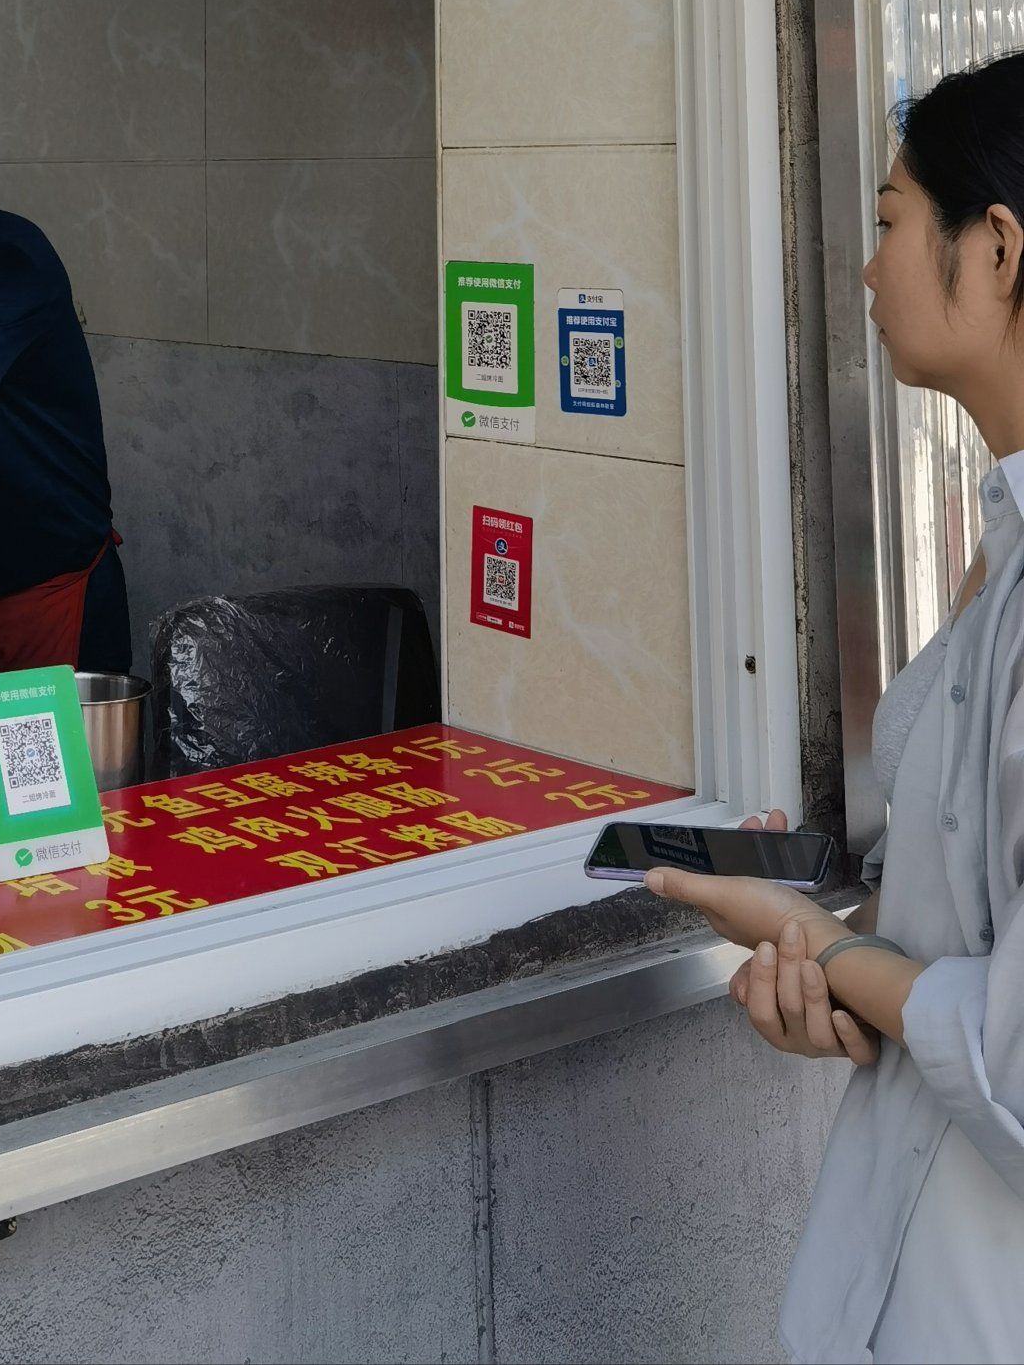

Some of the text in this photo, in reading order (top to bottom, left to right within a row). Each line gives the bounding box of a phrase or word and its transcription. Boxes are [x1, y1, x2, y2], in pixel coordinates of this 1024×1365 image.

[457, 275, 522, 291] 推荐使用微信支付
[478, 414, 520, 432] 微信支付
[482, 514, 523, 534] 扫码领红包
[264, 810, 527, 877] 双汇烤肠
[544, 780, 651, 811] 2元
[35, 840, 82, 861] 微信支付
